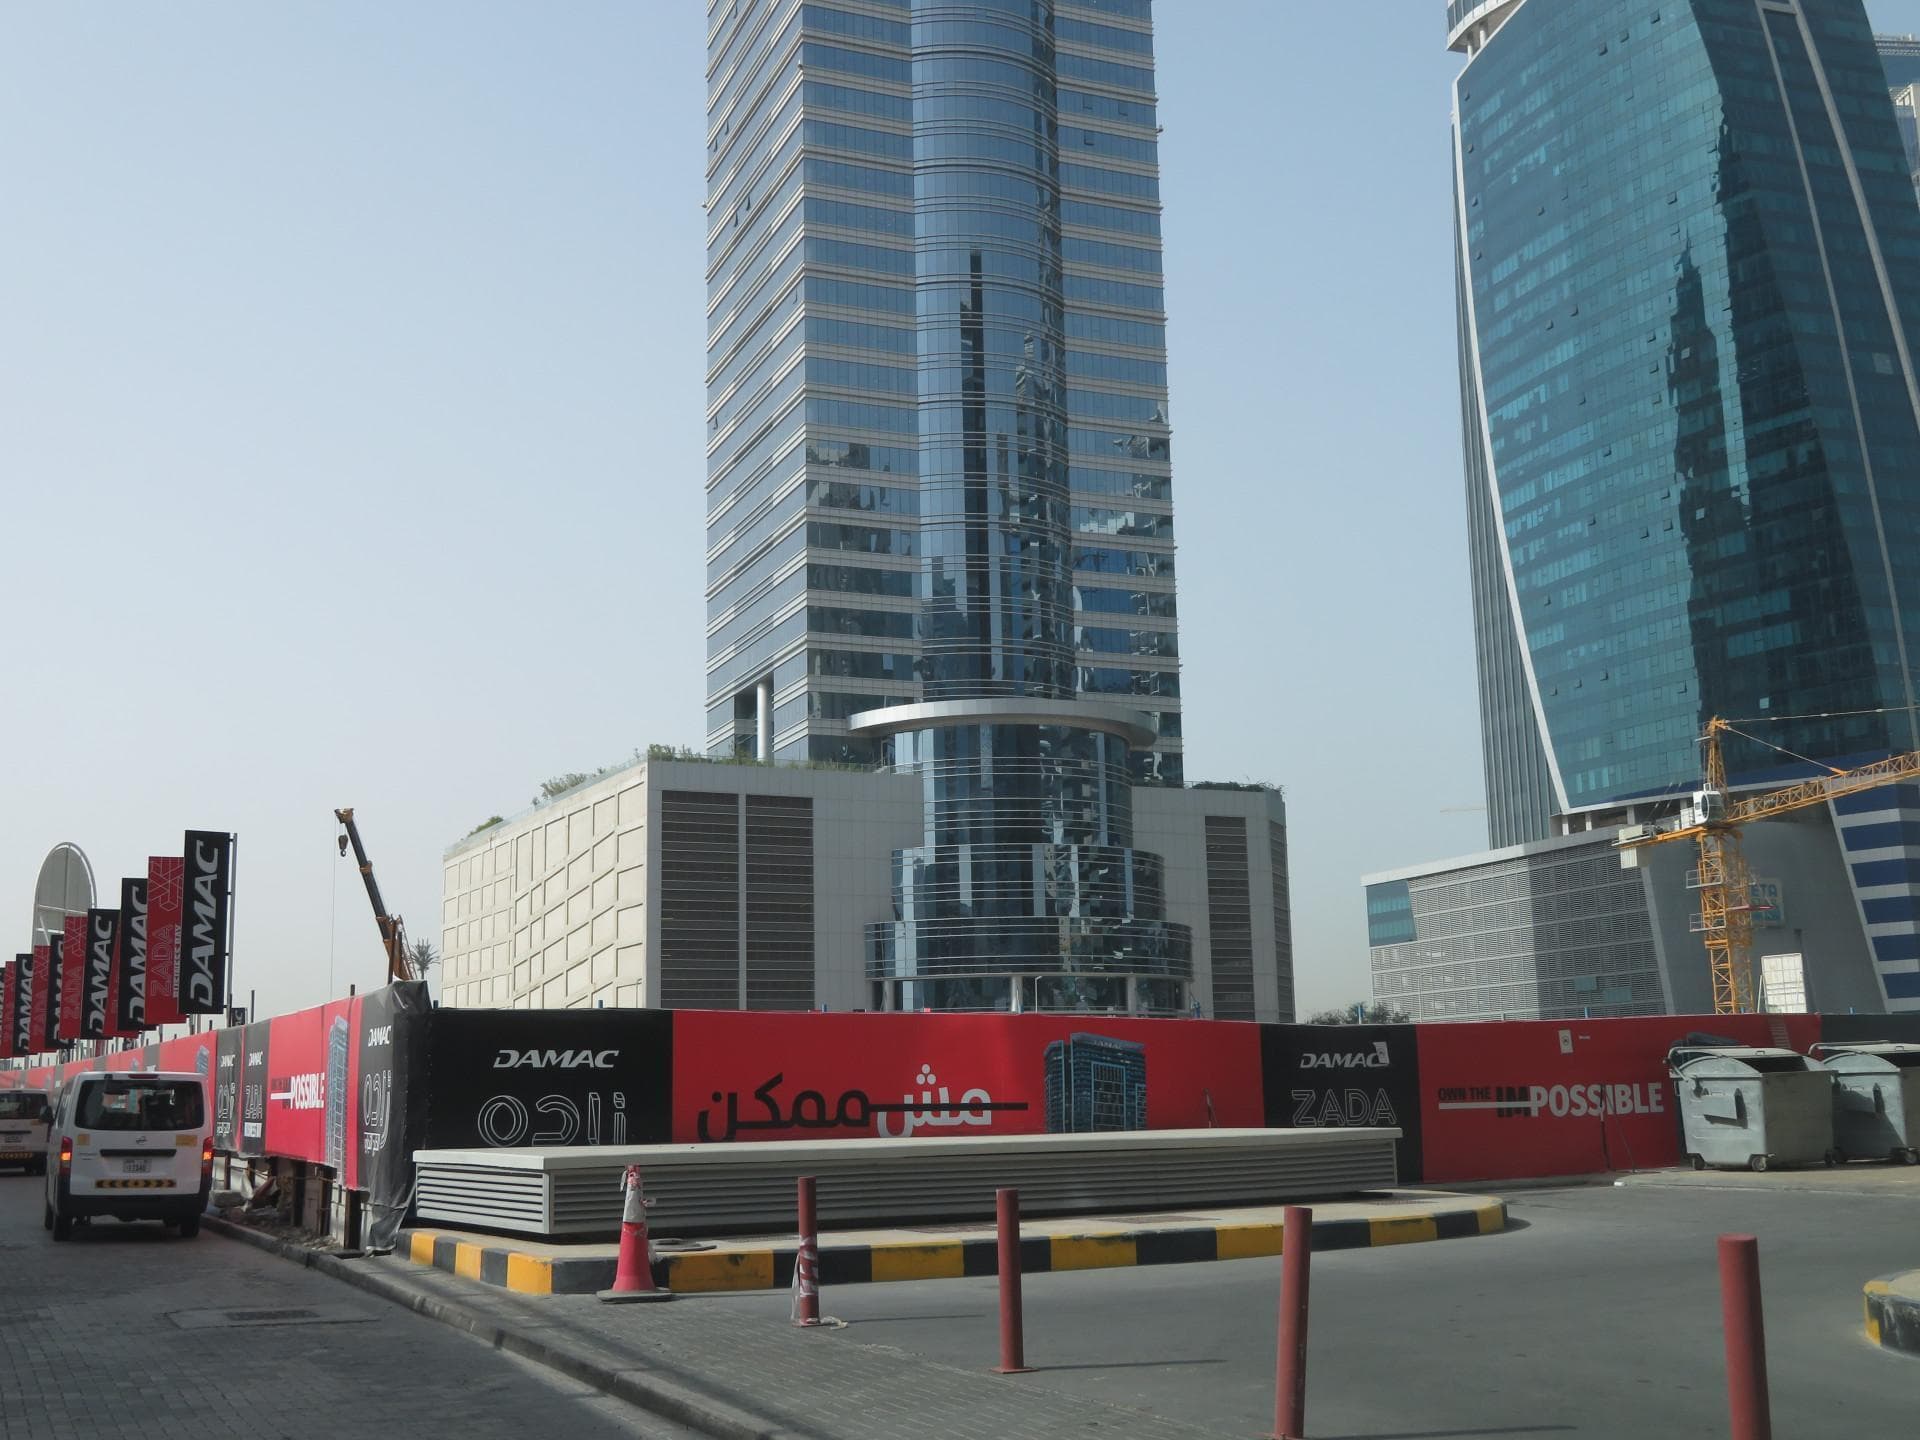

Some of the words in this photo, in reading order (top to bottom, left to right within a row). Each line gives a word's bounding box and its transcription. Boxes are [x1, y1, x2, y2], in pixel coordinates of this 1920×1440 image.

[129, 886, 148, 1024] DAMAC
[190, 839, 219, 1007] DAMAC
[89, 915, 112, 1034] DAMAC
[492, 1050, 619, 1068] DAMAC
[1470, 1087, 1491, 1100] THE
[1291, 1088, 1398, 1127] ZADA
